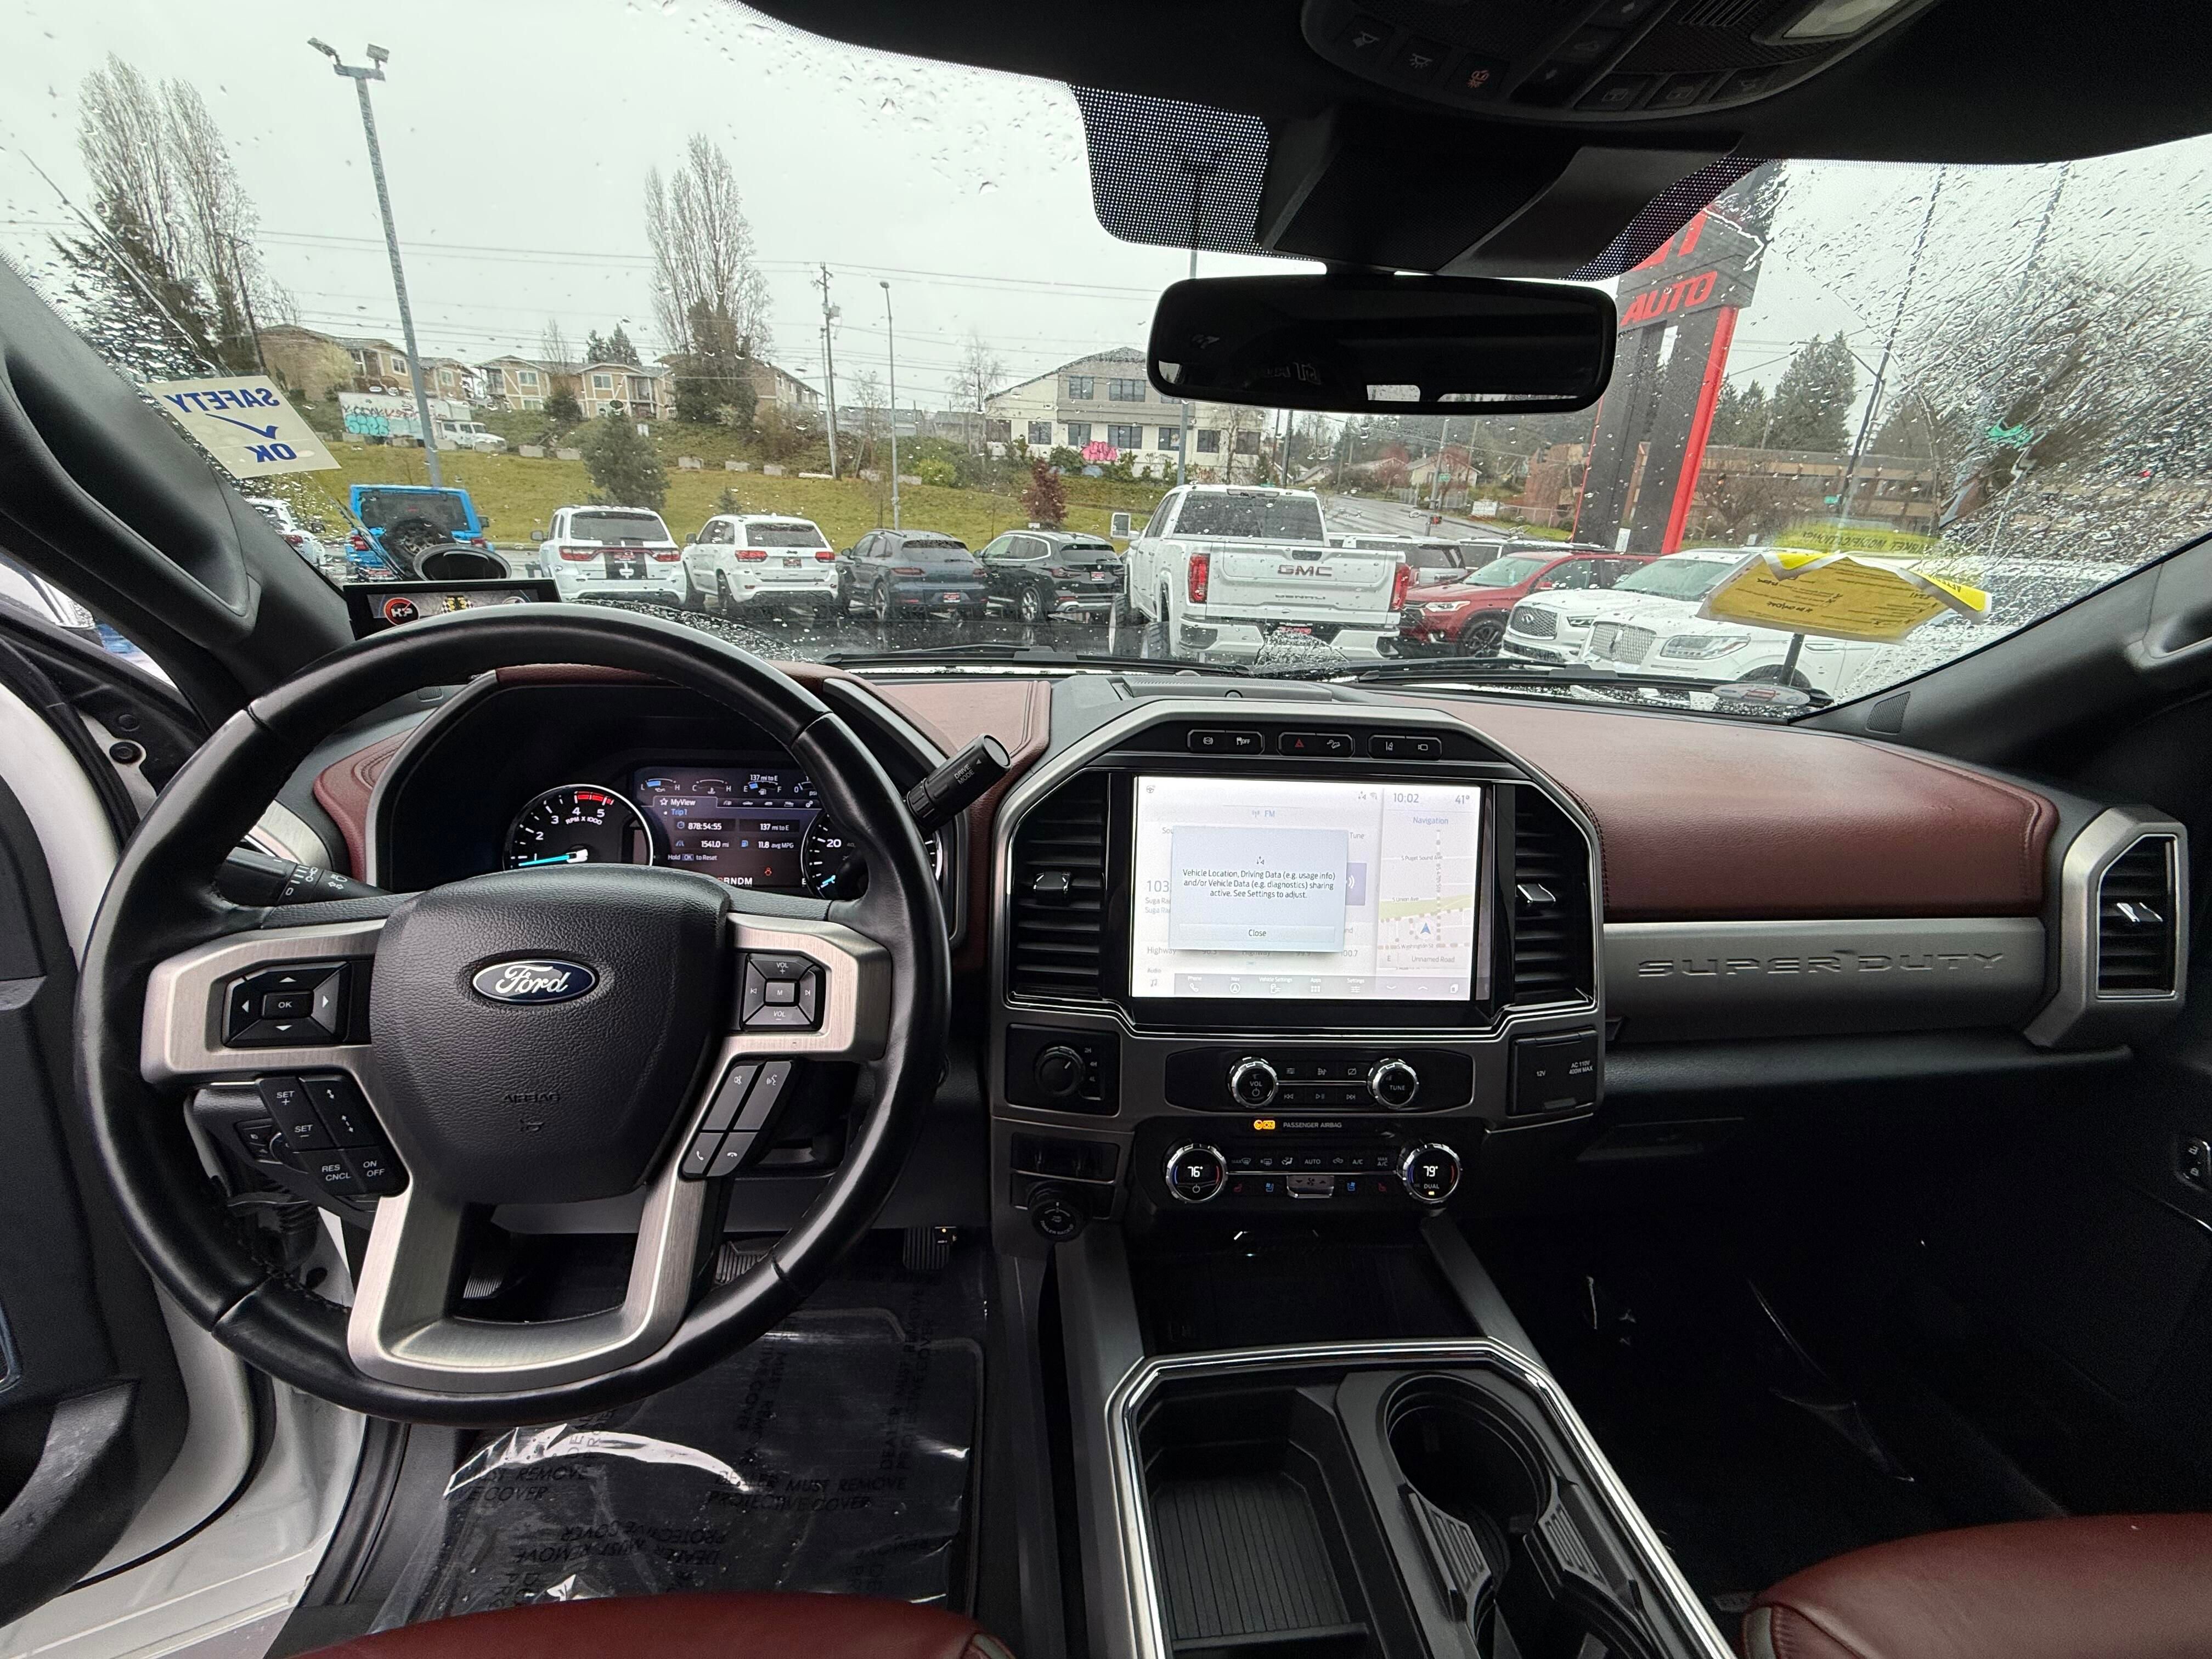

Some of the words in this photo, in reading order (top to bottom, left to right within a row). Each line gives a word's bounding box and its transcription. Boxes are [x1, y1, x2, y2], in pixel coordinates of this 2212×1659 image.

[1619, 270, 1718, 326] AUTO
[1278, 565, 1333, 577] GMC
[953, 763, 972, 779] DRIVE
[957, 769, 975, 785] MODE
[1393, 793, 1419, 803] 10:02
[1455, 795, 1470, 804] 41°
[572, 807, 581, 815] 4
[597, 809, 605, 817] 5
[1264, 810, 1276, 818] FM
[551, 815, 559, 824] 3
[587, 817, 602, 825] 1000
[1413, 816, 1448, 825] Navigation
[535, 831, 544, 840] 2
[826, 839, 842, 848] 20
[1183, 869, 1207, 877] Vehicle
[1209, 870, 1239, 878] Location,
[1240, 870, 1263, 879] Driving
[1283, 871, 1297, 880] (e.g.
[1299, 873, 1318, 881] usage
[1319, 872, 1335, 881] info)
[1184, 879, 1207, 887] and/or
[1209, 879, 1232, 888] Vehicle
[1251, 881, 1266, 889] (e.g.
[1267, 881, 1308, 889] diagnostics)
[1310, 882, 1334, 890] sharing
[1247, 890, 1275, 899] Settings
[1285, 891, 1307, 900] adjust.
[1638, 956, 1842, 978] SUPER
[1858, 952, 2005, 972] DUTY
[495, 965, 572, 994] Ford
[276, 1091, 294, 1099] SET
[503, 1093, 561, 1103] AIRBAG
[295, 1125, 313, 1133] SET
[321, 1164, 341, 1172] RES
[363, 1160, 377, 1168] ON
[325, 1172, 351, 1181] CNCL
[366, 1168, 385, 1177] OFF
[515, 1466, 588, 1482] REMOVE
[785, 1479, 830, 1492] MUST
[837, 1476, 907, 1492] REMOVE
[484, 1486, 549, 1502] COVER
[812, 1496, 872, 1511] COVER
[561, 1520, 619, 1542] COVER
[515, 1542, 594, 1564] REMOVE
